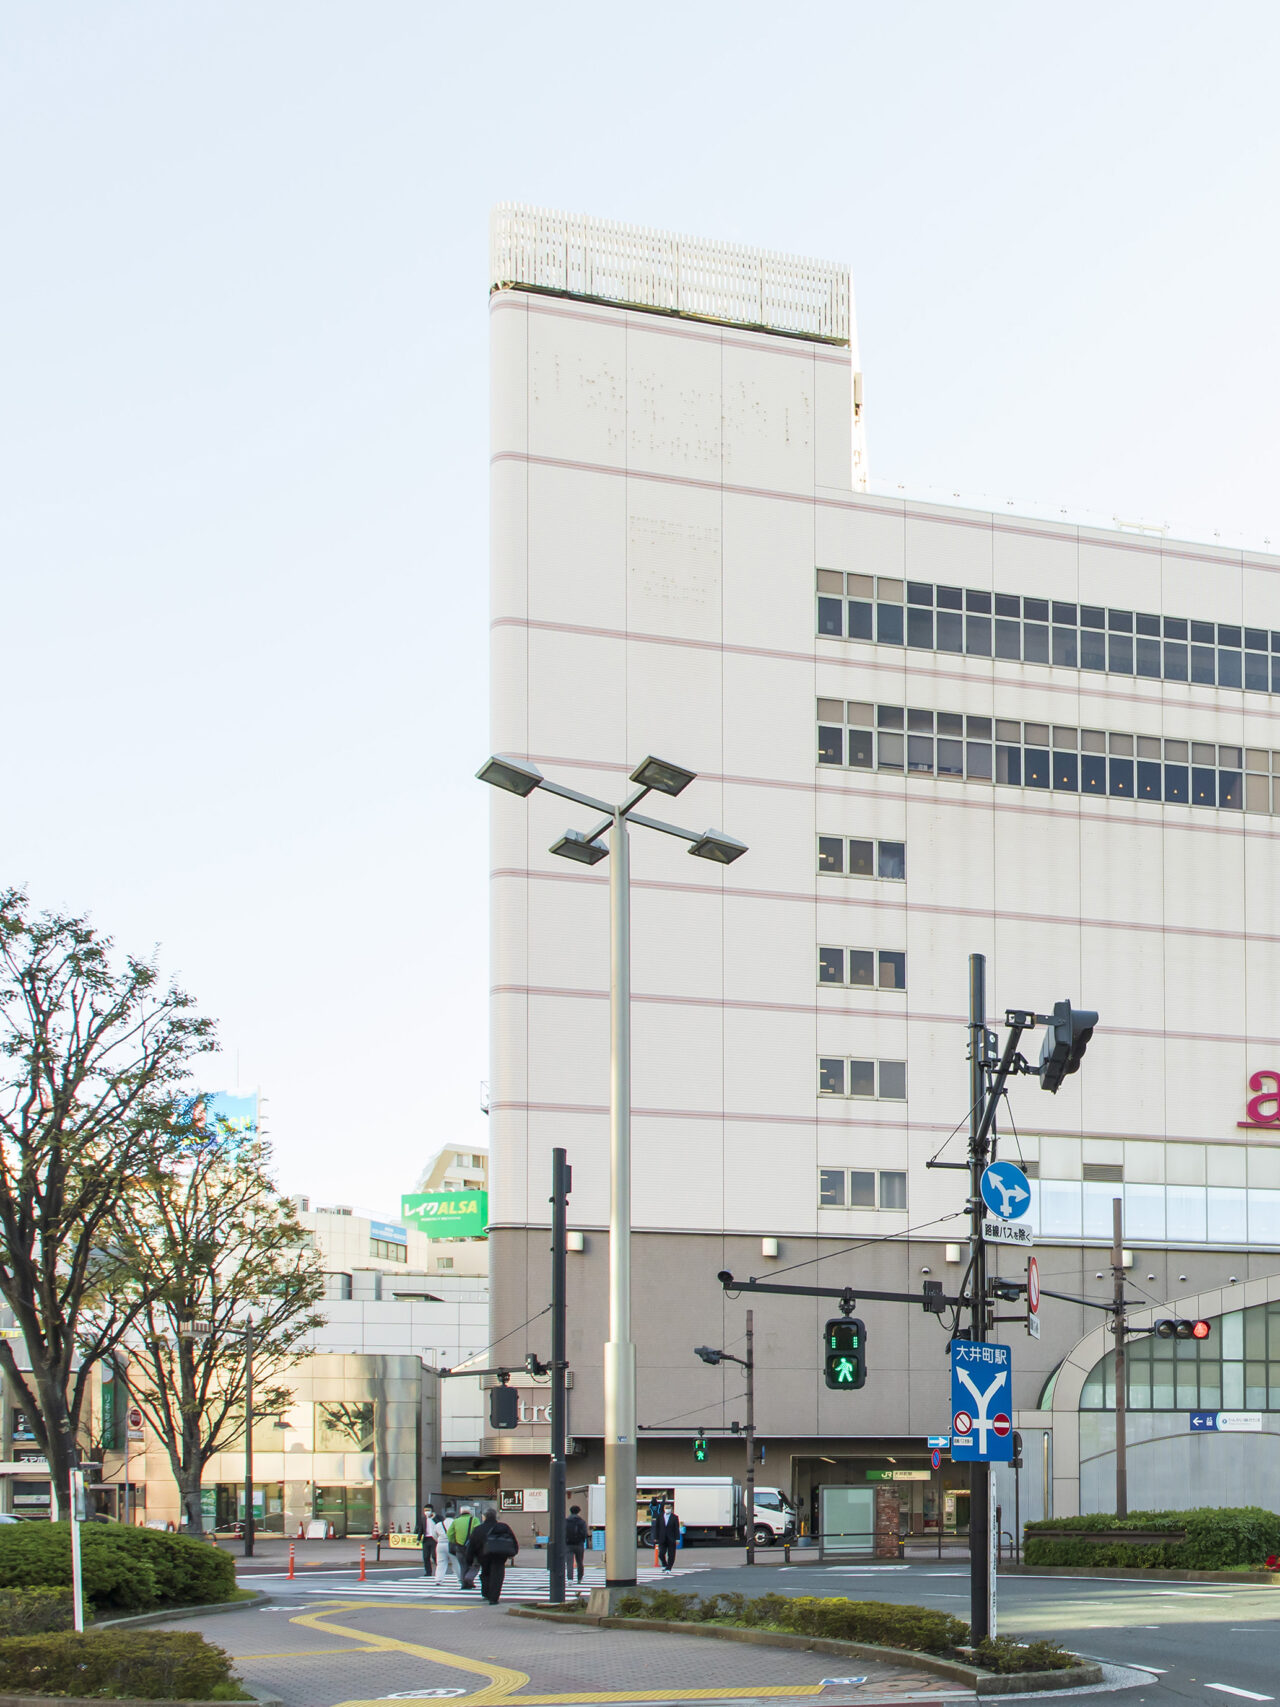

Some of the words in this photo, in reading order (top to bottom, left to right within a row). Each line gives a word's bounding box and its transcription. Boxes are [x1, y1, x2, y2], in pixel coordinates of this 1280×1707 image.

[403, 1200, 478, 1217] レイクALSA
[984, 1223, 1031, 1242] 路線バスを除く
[956, 1344, 1008, 1365] 大井町駅
[518, 1400, 552, 1422] tré
